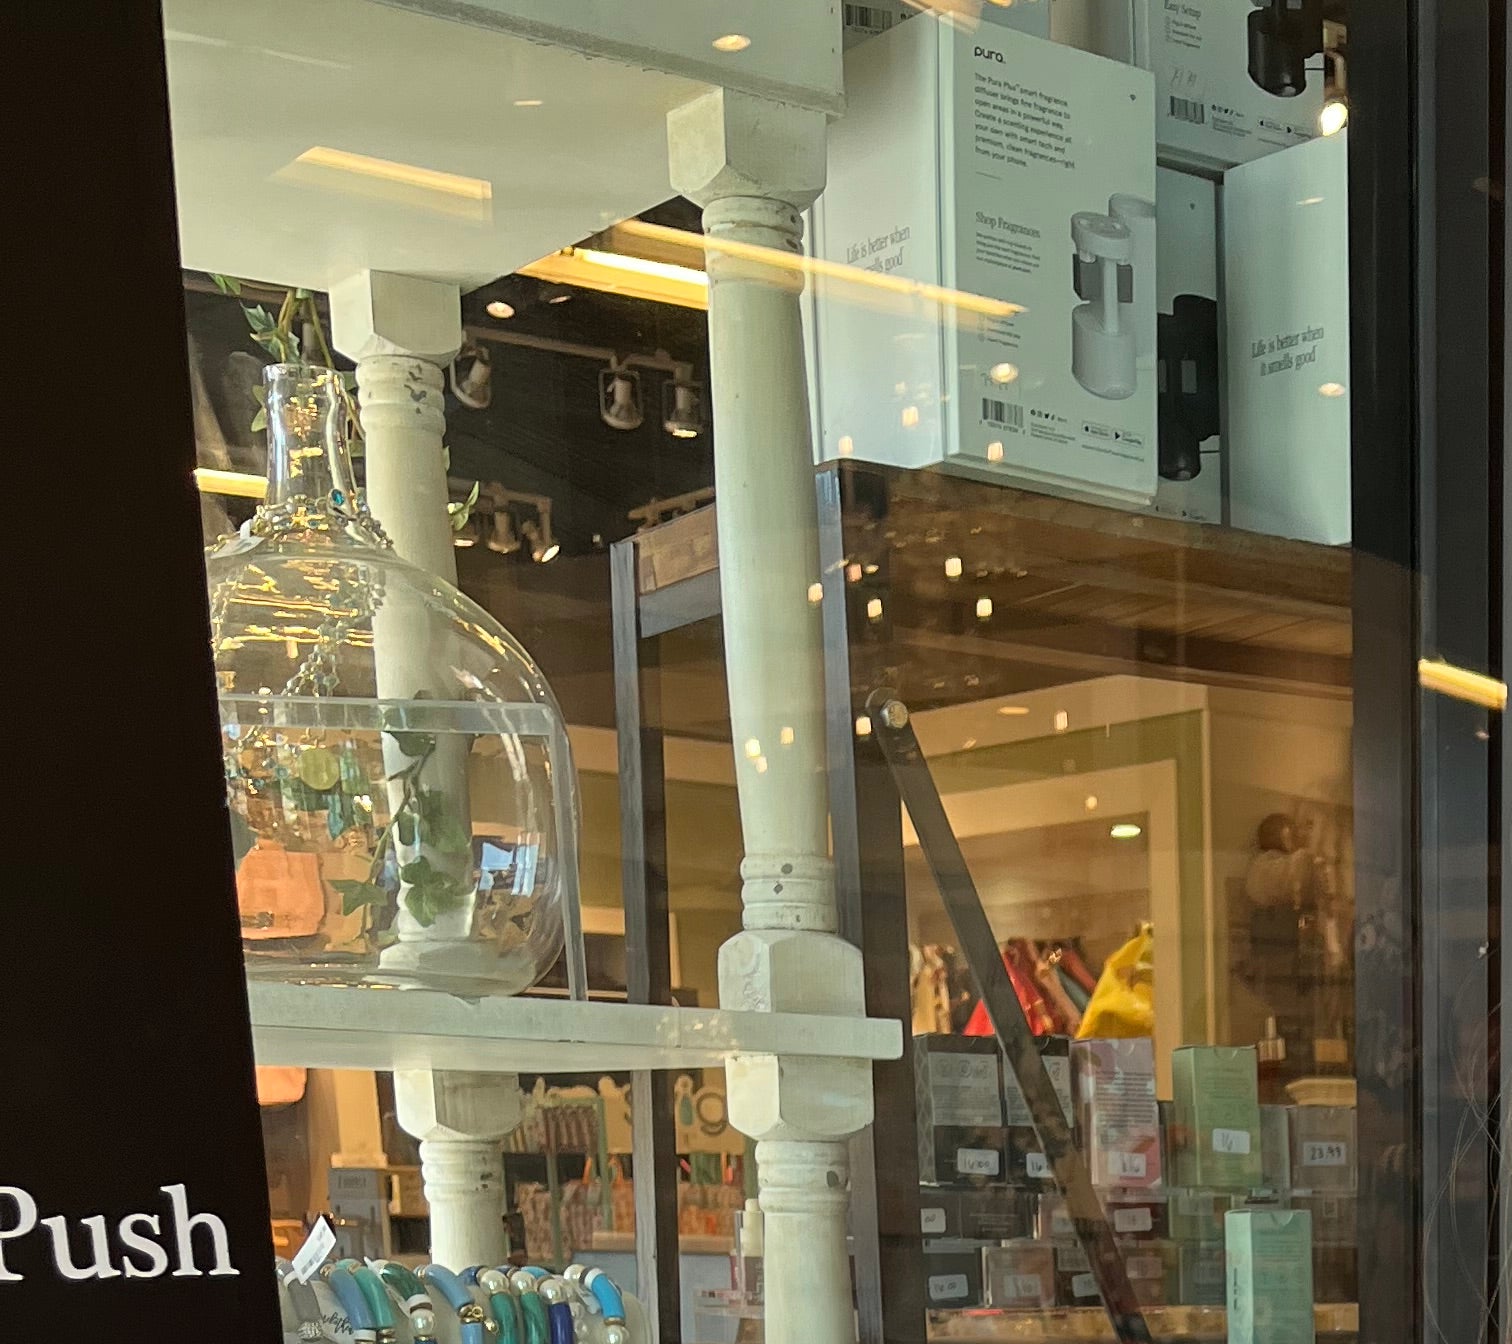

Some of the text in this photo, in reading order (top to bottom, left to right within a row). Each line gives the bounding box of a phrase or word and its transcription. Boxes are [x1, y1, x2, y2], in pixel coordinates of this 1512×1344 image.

[975, 210, 998, 230] Shop
[846, 243, 860, 265] Life
[867, 236, 889, 256] better
[889, 225, 911, 246] when
[1251, 340, 1267, 360] Life
[1276, 334, 1300, 352] better
[1301, 325, 1325, 342] when
[1267, 352, 1293, 375] smells
[1295, 345, 1318, 371] good
[0, 1183, 241, 1282] Push
